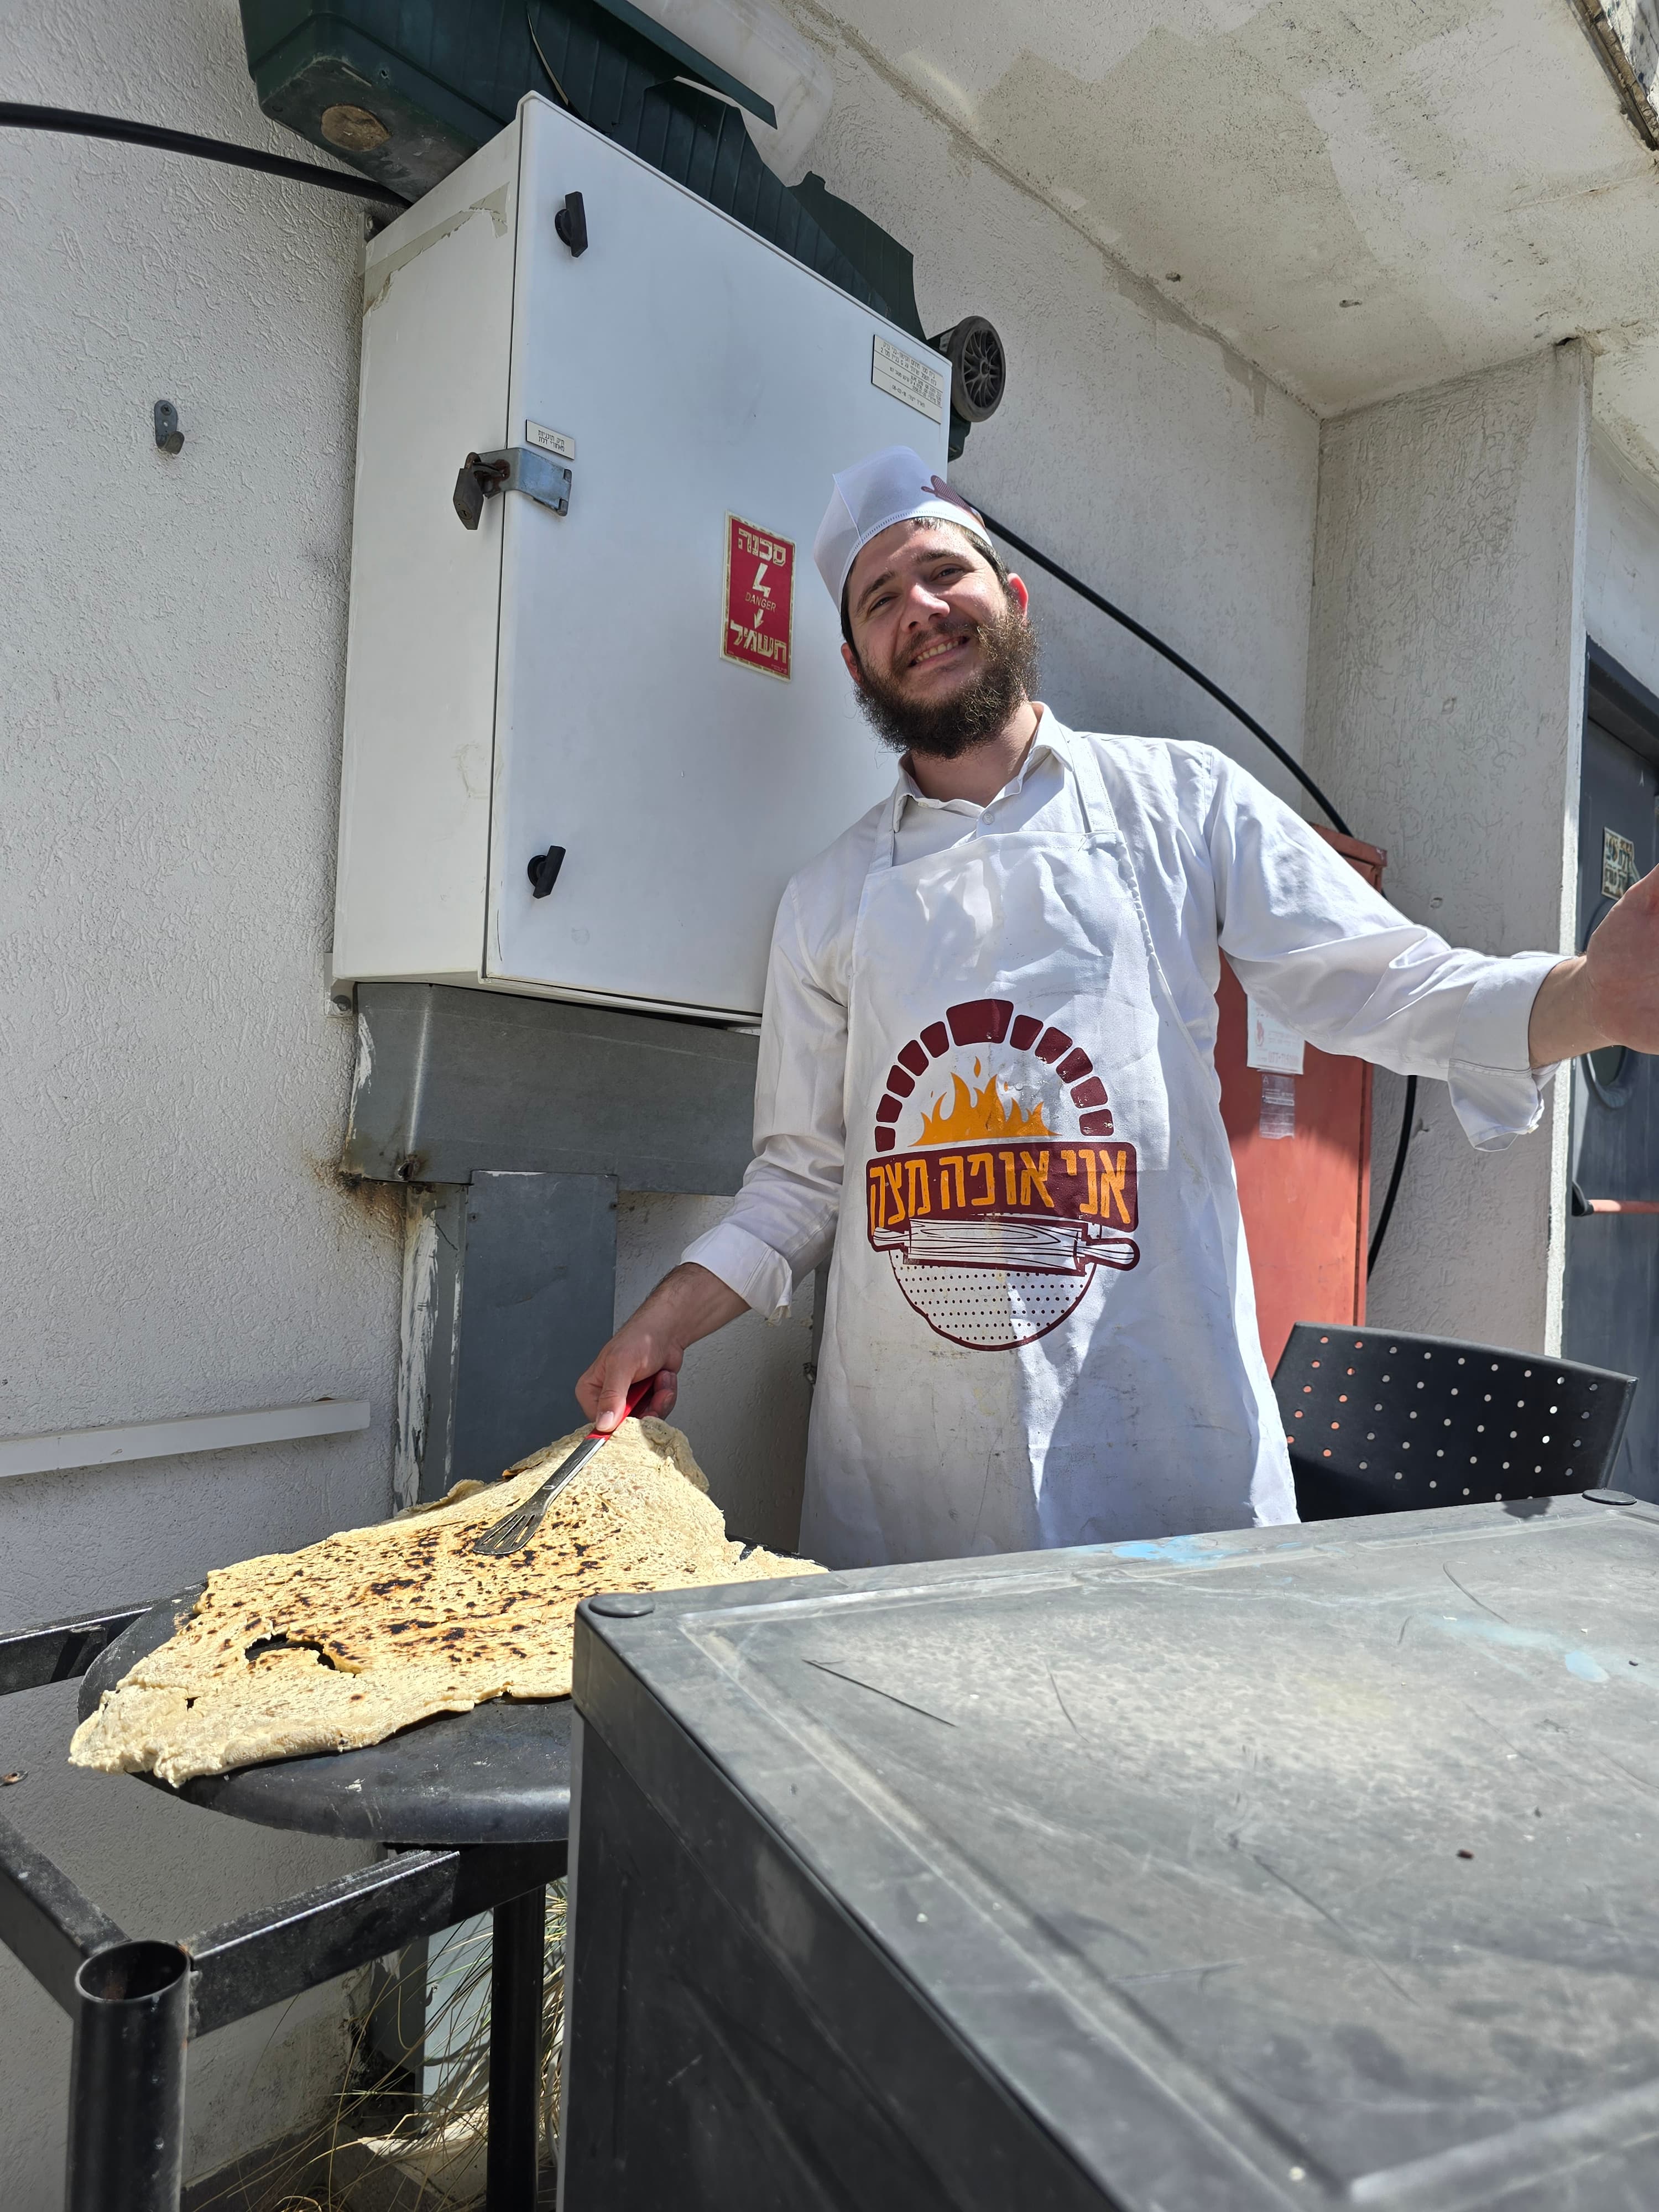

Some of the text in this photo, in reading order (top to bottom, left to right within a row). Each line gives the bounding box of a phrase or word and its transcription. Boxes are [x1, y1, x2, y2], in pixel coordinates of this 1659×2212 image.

[538, 430, 555, 441] תוכניות
[539, 436, 565, 452] מאחורי דלת
[738, 528, 786, 567] סכנה
[745, 591, 776, 612] DANGER
[730, 620, 787, 664] חשמל
[870, 1149, 1131, 1235] אני אופה מצה
